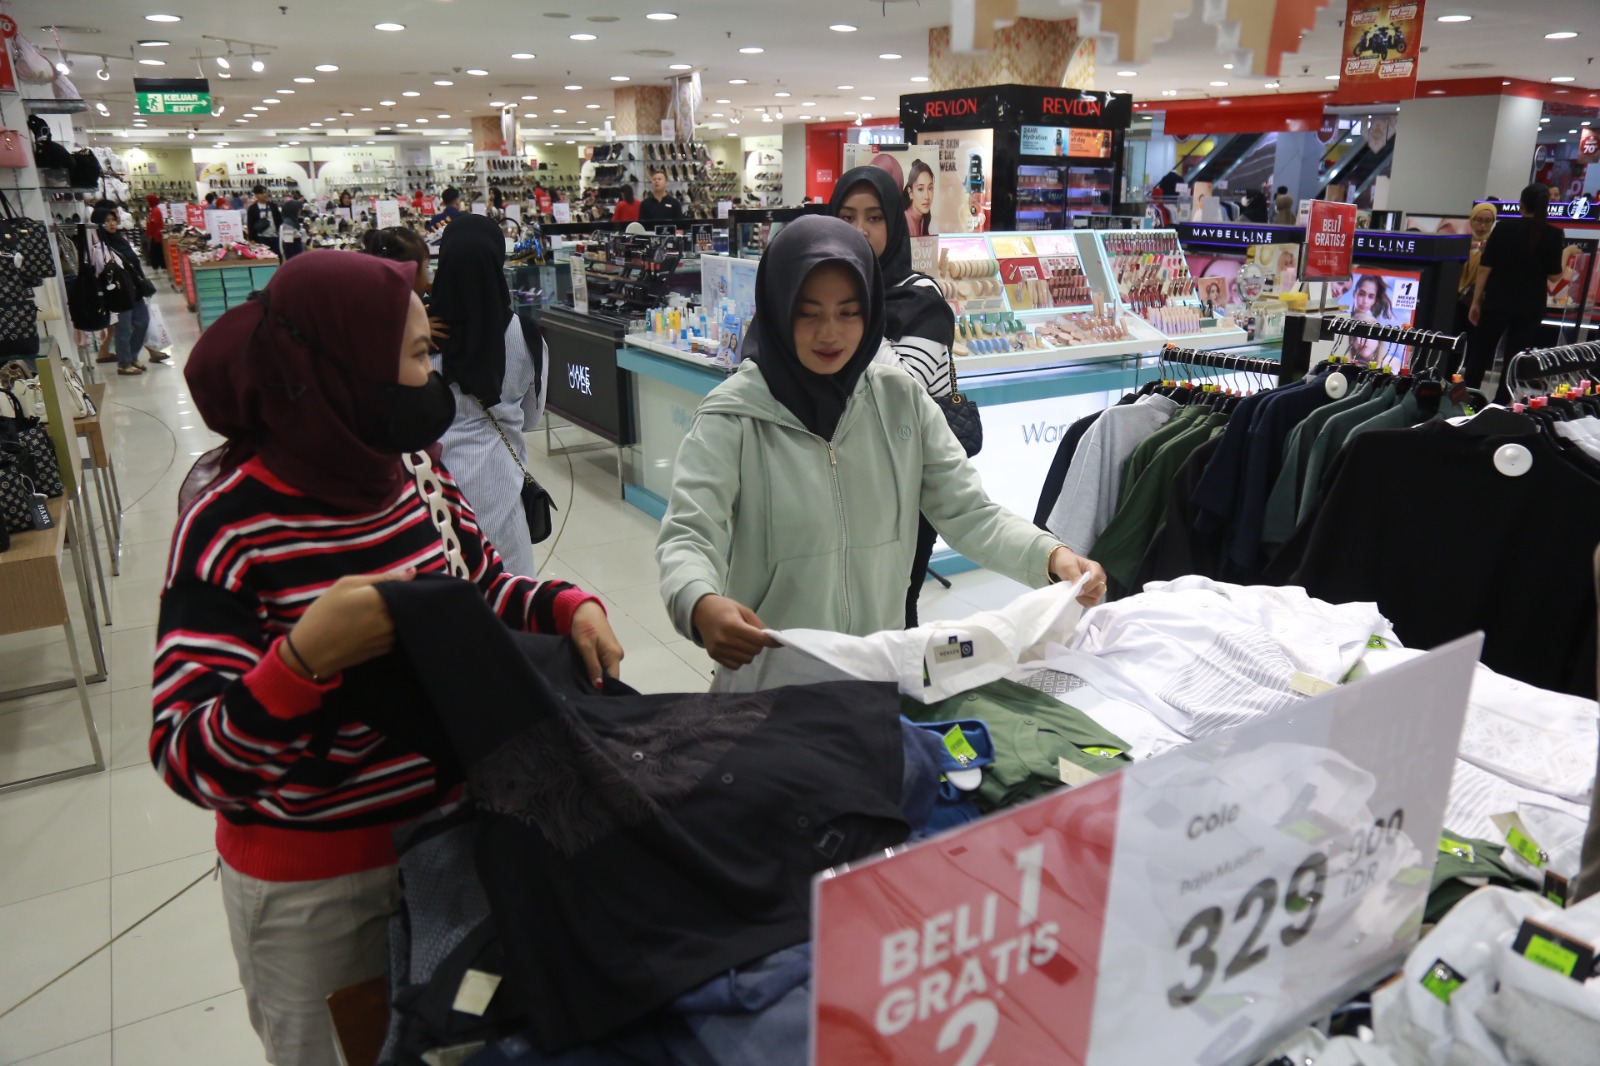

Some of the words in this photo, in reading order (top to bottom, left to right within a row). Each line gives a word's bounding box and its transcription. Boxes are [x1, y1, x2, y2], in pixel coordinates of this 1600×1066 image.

[926, 97, 977, 117] REVLON
[1043, 97, 1101, 117] REVLON
[946, 138, 960, 149] SKIN
[1322, 218, 1337, 232] BELI
[1337, 214, 1342, 233] 1
[1193, 228, 1272, 241] MAYBELLINE
[1315, 232, 1341, 247] GRATIS
[911, 247, 932, 260] OW
[911, 260, 932, 270] HION
[1022, 421, 1070, 445] War
[1187, 803, 1240, 840] Cole
[1343, 861, 1379, 897] IDR
[880, 893, 998, 986] BELI
[1015, 842, 1045, 928] 1
[1167, 852, 1329, 1009] 329
[874, 921, 1060, 1036] GRATIS
